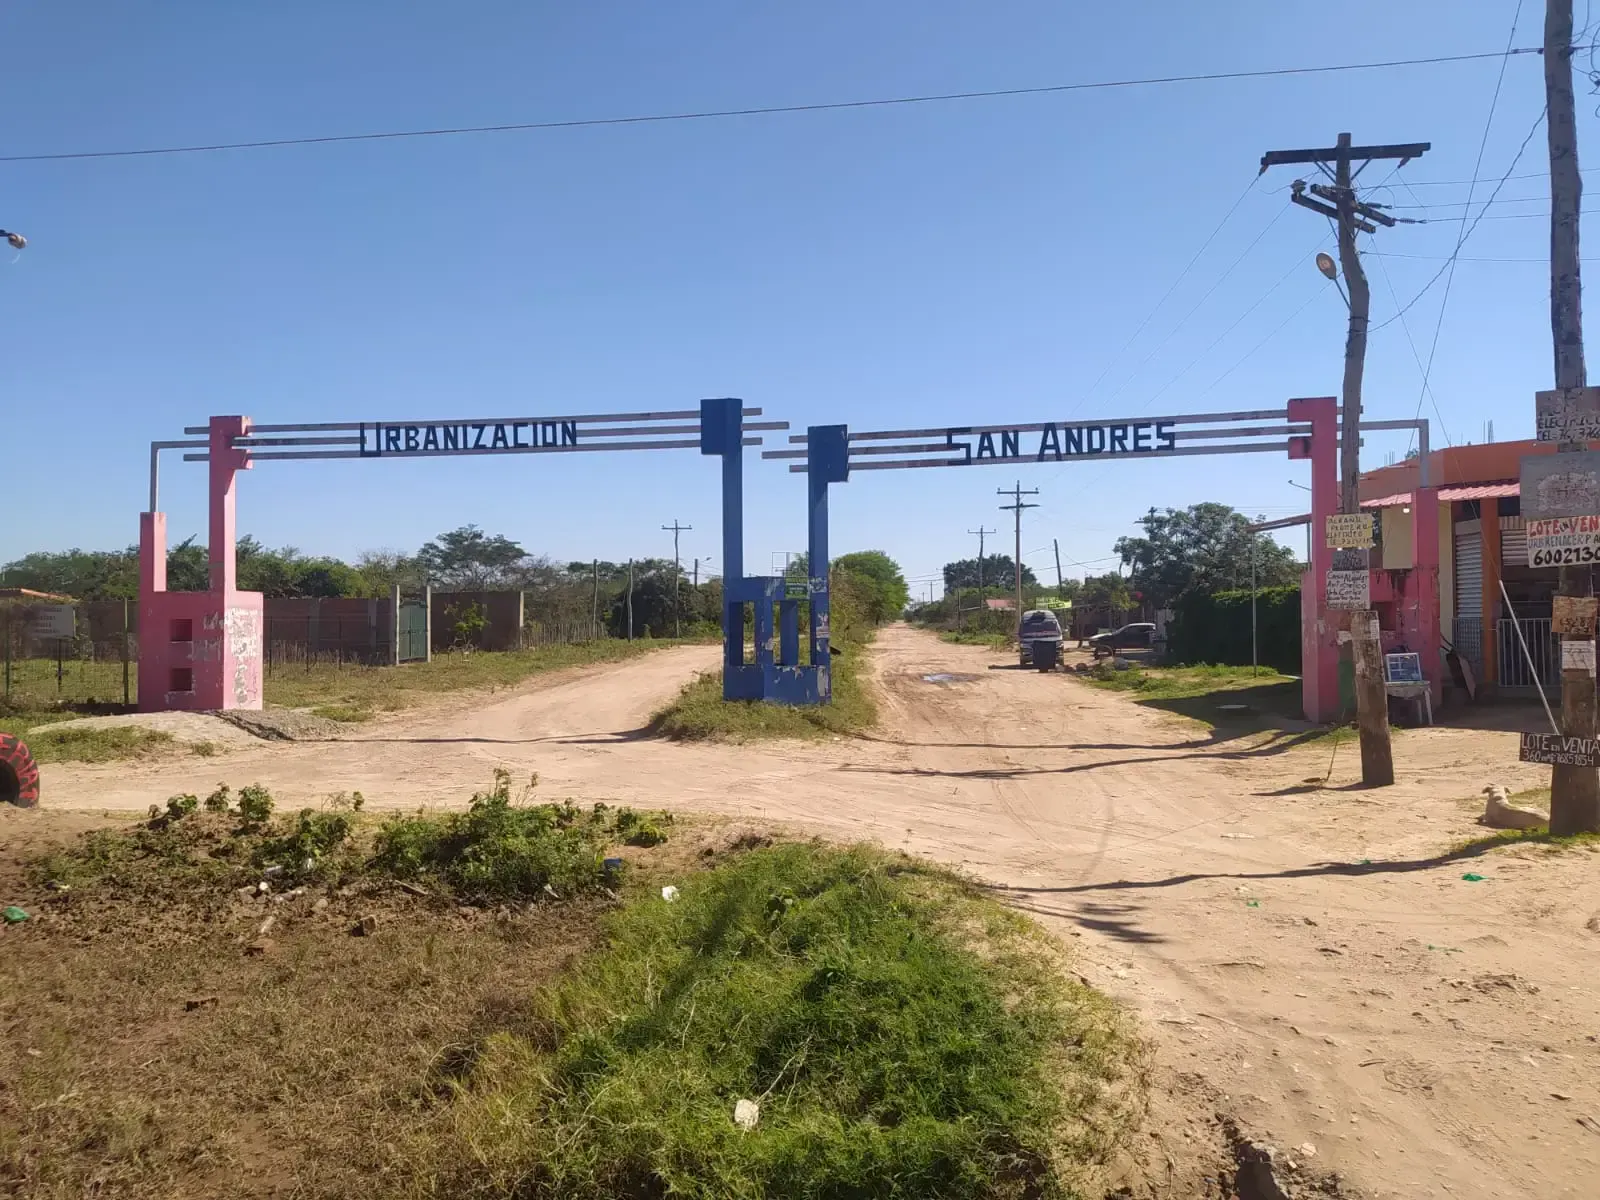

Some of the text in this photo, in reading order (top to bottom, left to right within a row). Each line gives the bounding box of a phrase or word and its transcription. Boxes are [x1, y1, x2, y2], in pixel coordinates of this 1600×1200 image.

[360, 420, 1175, 465] URBANIZACION SAN ANDRES
[1568, 515, 1600, 534] VEN
[1521, 733, 1550, 750] LOTE
[1561, 736, 1600, 755] VENTA
